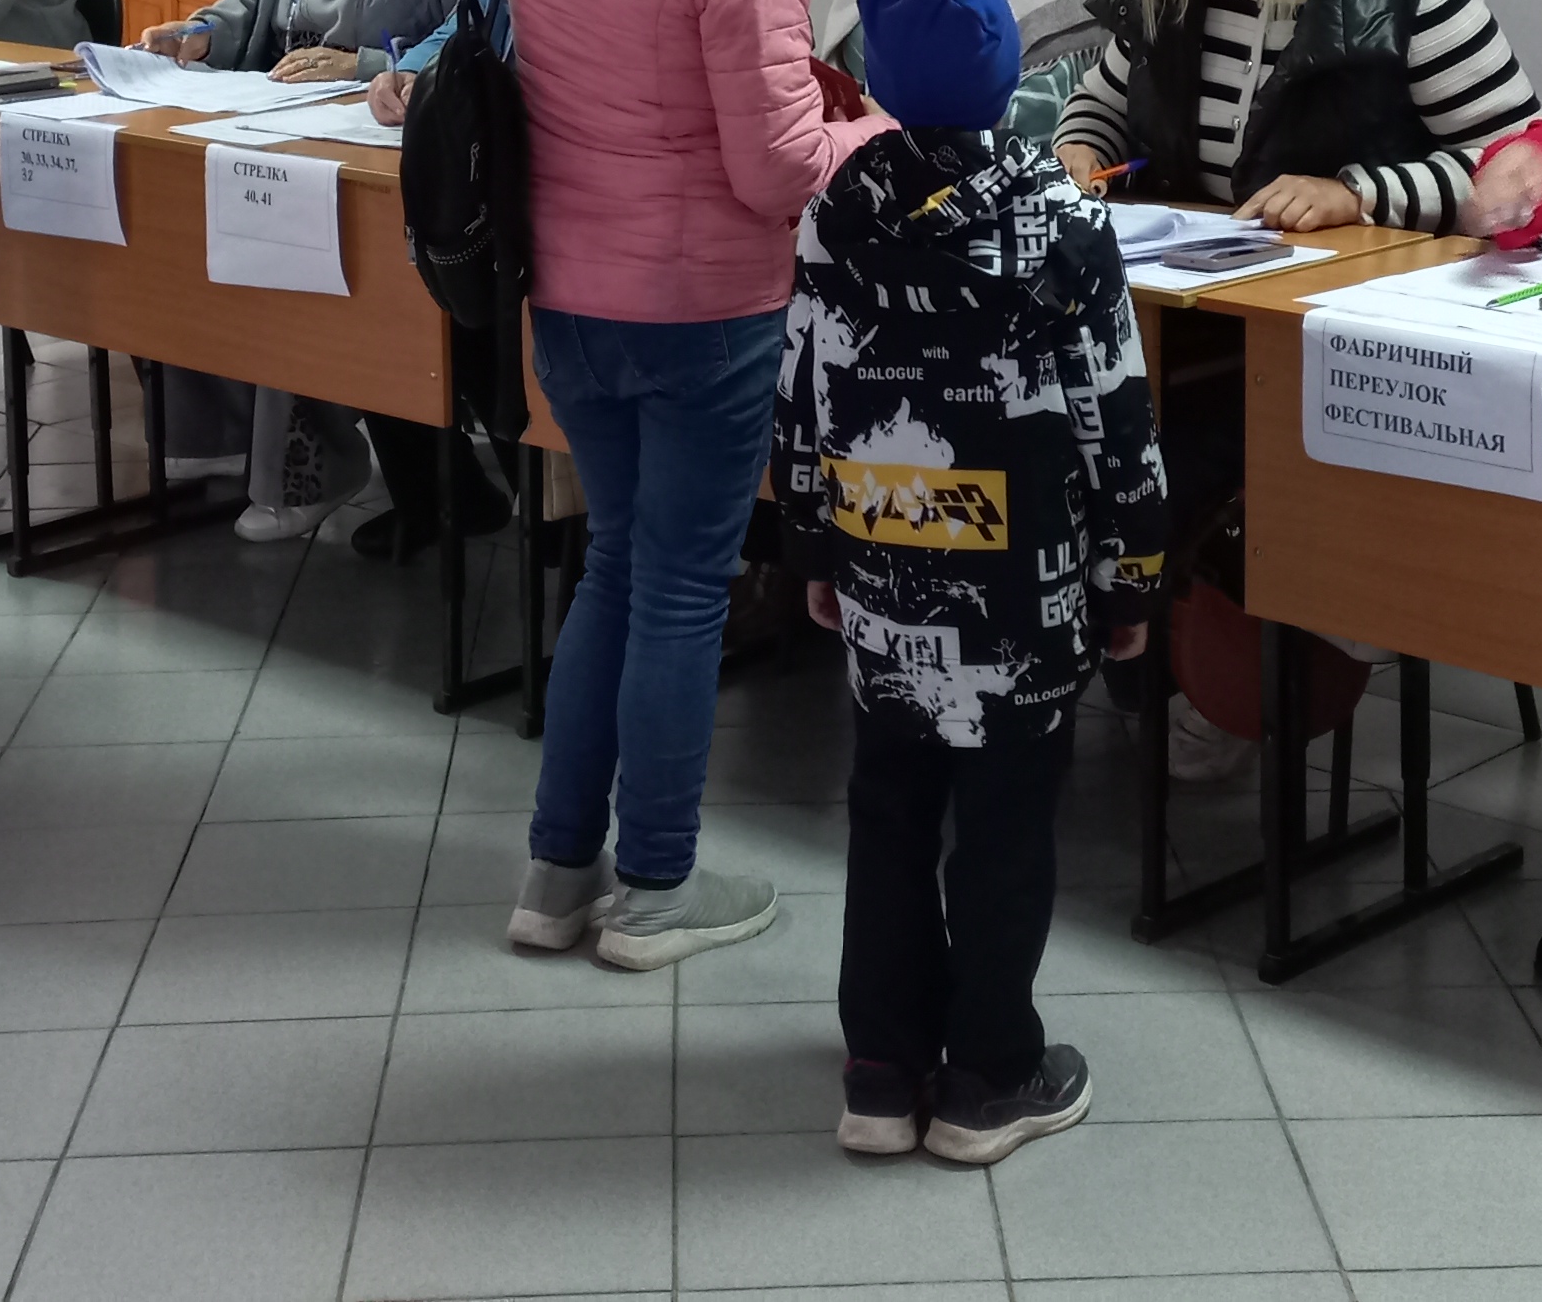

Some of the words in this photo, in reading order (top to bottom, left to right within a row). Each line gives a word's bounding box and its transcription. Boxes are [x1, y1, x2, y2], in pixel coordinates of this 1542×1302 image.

[22, 127, 71, 147] СТРЕЛКА
[233, 161, 288, 183] СТРЕЛКА
[260, 191, 272, 206] 41
[922, 345, 951, 360] with
[1329, 334, 1473, 376] ФАБРИЧНЫЙ
[857, 366, 925, 382] DALOGUE
[942, 385, 996, 403] earth
[1329, 368, 1447, 407] ПЕРЕУЛОК
[1324, 402, 1506, 453] ФЕСТИВАЛЬНАЯ
[1115, 478, 1156, 505] earth
[1013, 680, 1078, 707] DALOGUE
